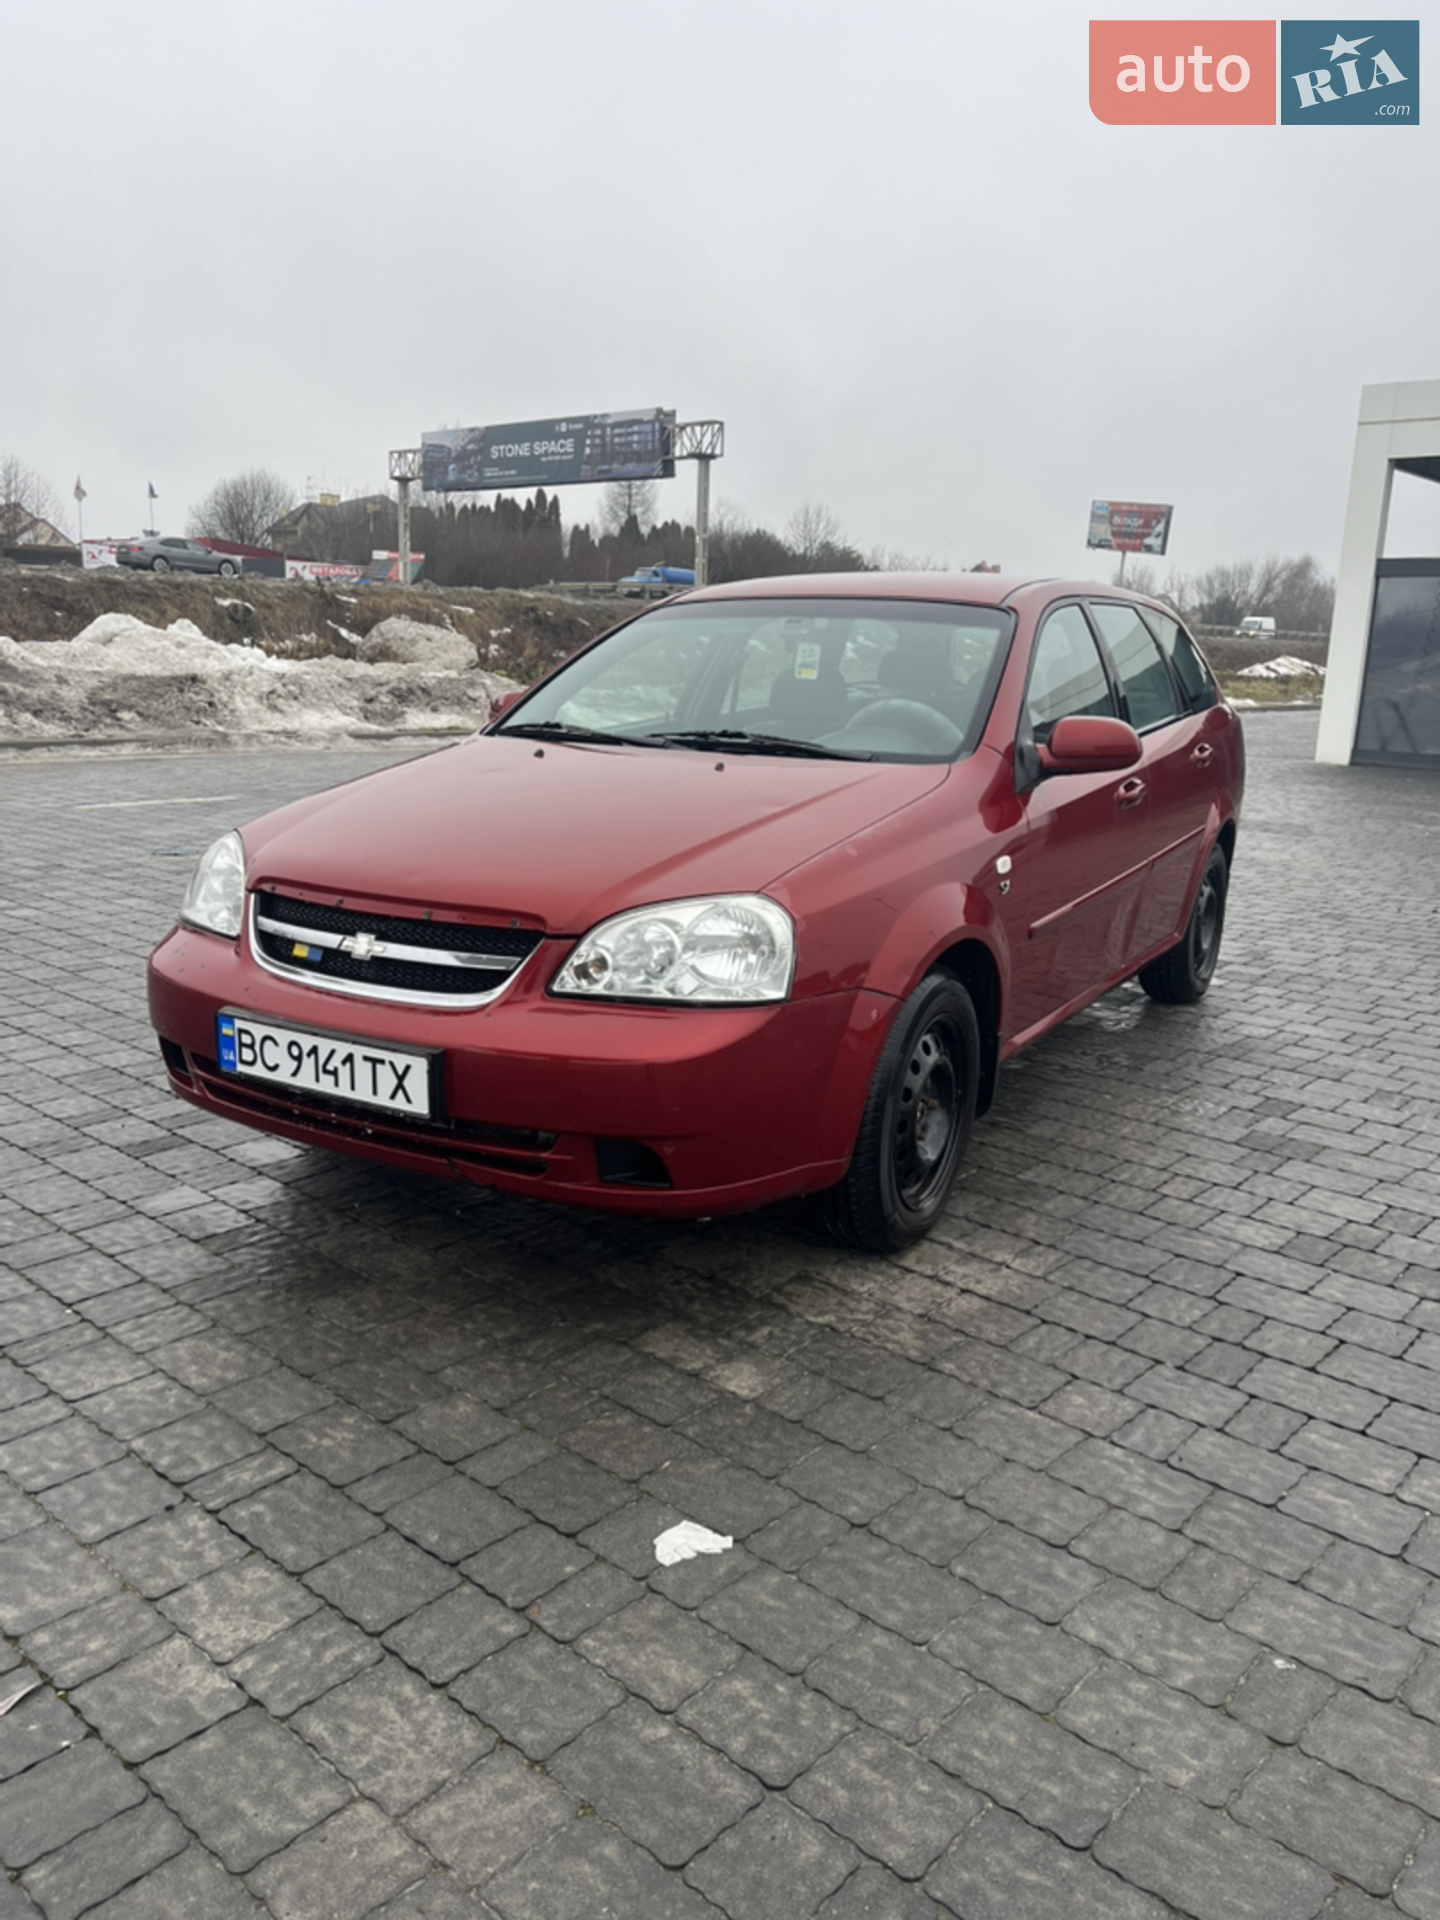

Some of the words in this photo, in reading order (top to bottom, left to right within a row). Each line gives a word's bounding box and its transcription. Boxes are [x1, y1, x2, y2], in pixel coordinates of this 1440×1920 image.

[490, 442, 531, 459] STONE
[532, 438, 575, 455] SPACE
[221, 1048, 236, 1061] UA
